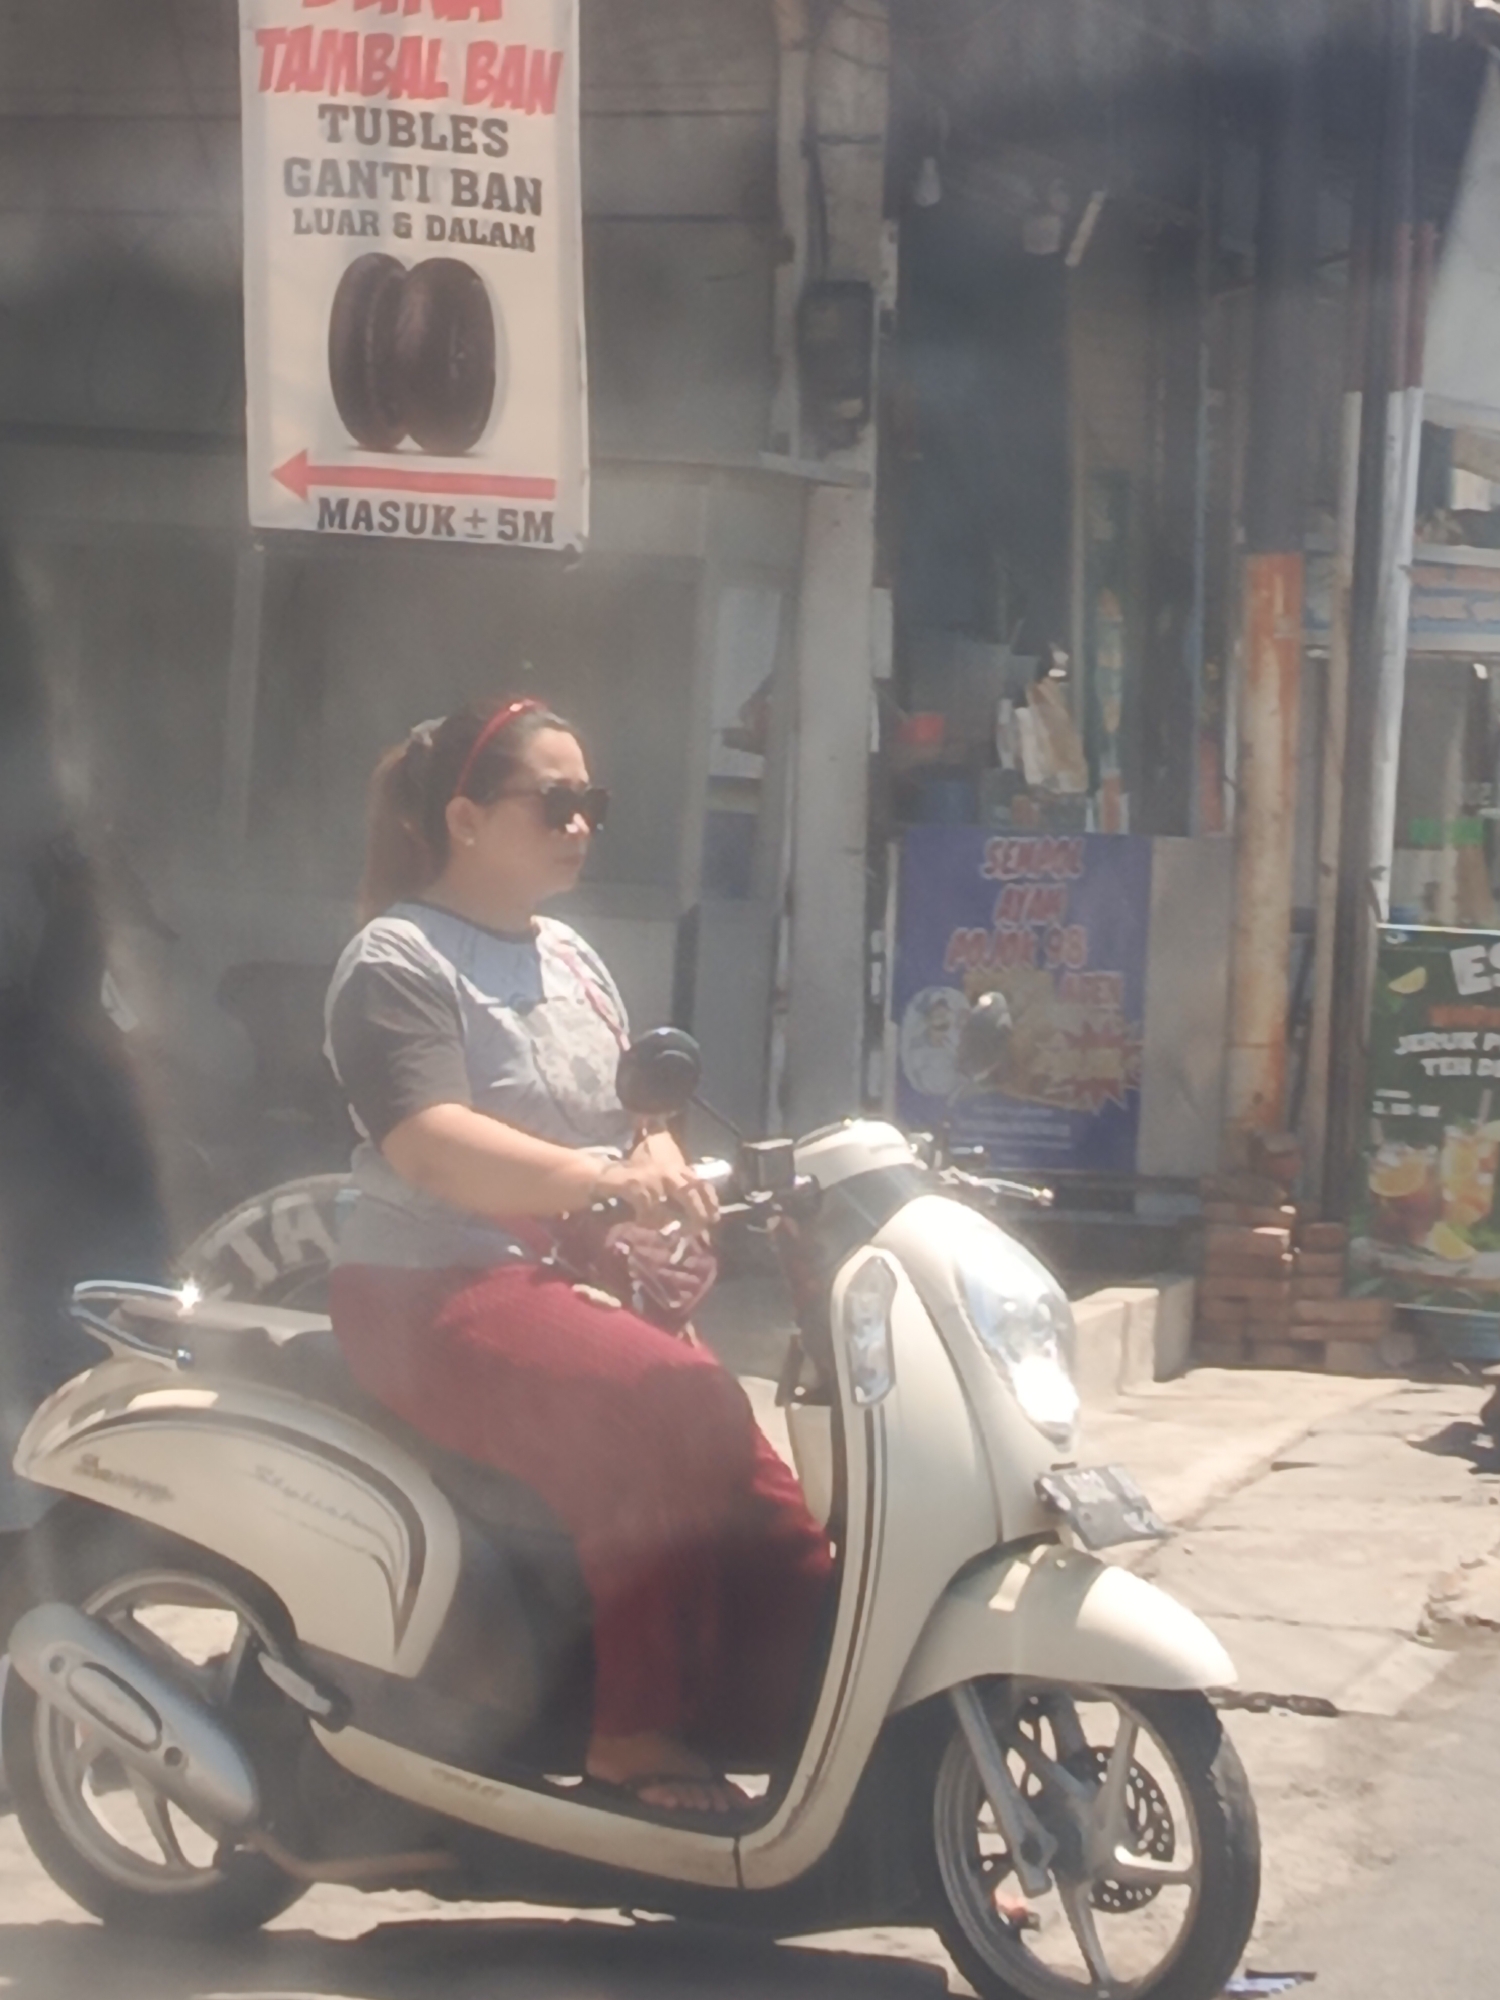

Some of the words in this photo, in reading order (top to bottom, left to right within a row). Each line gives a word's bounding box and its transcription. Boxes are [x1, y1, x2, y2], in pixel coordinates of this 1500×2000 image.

[255, 25, 449, 100] TAMBAL
[463, 40, 564, 115] BAN
[318, 103, 509, 158] TUBLES
[283, 156, 430, 203] GANTI
[450, 168, 542, 216] BAN
[293, 208, 380, 237] LUAR
[425, 214, 535, 252] DALAM
[317, 497, 456, 537] MASUK
[498, 508, 555, 543] 5M
